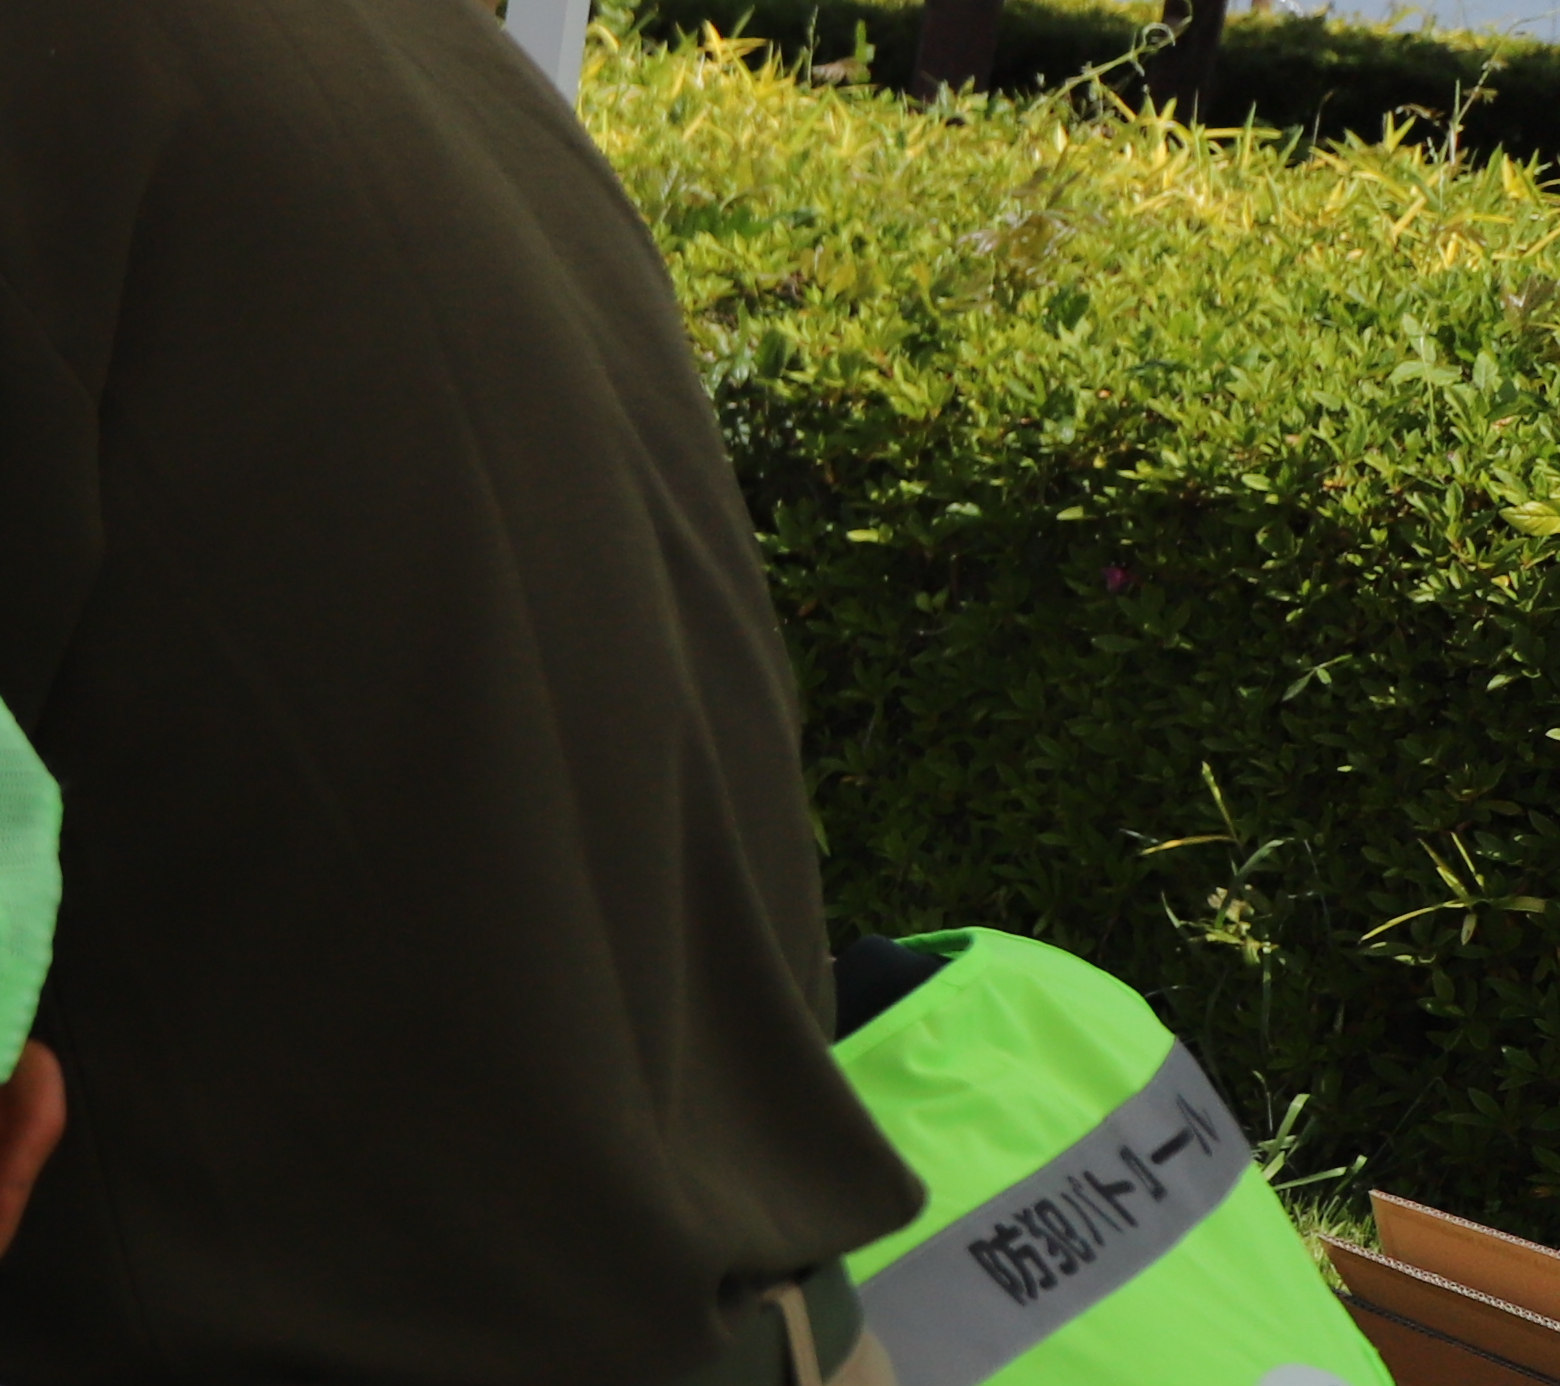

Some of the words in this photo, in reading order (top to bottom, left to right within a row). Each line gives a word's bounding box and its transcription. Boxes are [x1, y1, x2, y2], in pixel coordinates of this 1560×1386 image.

[968, 1093, 1220, 1307] 防犯パトロール
